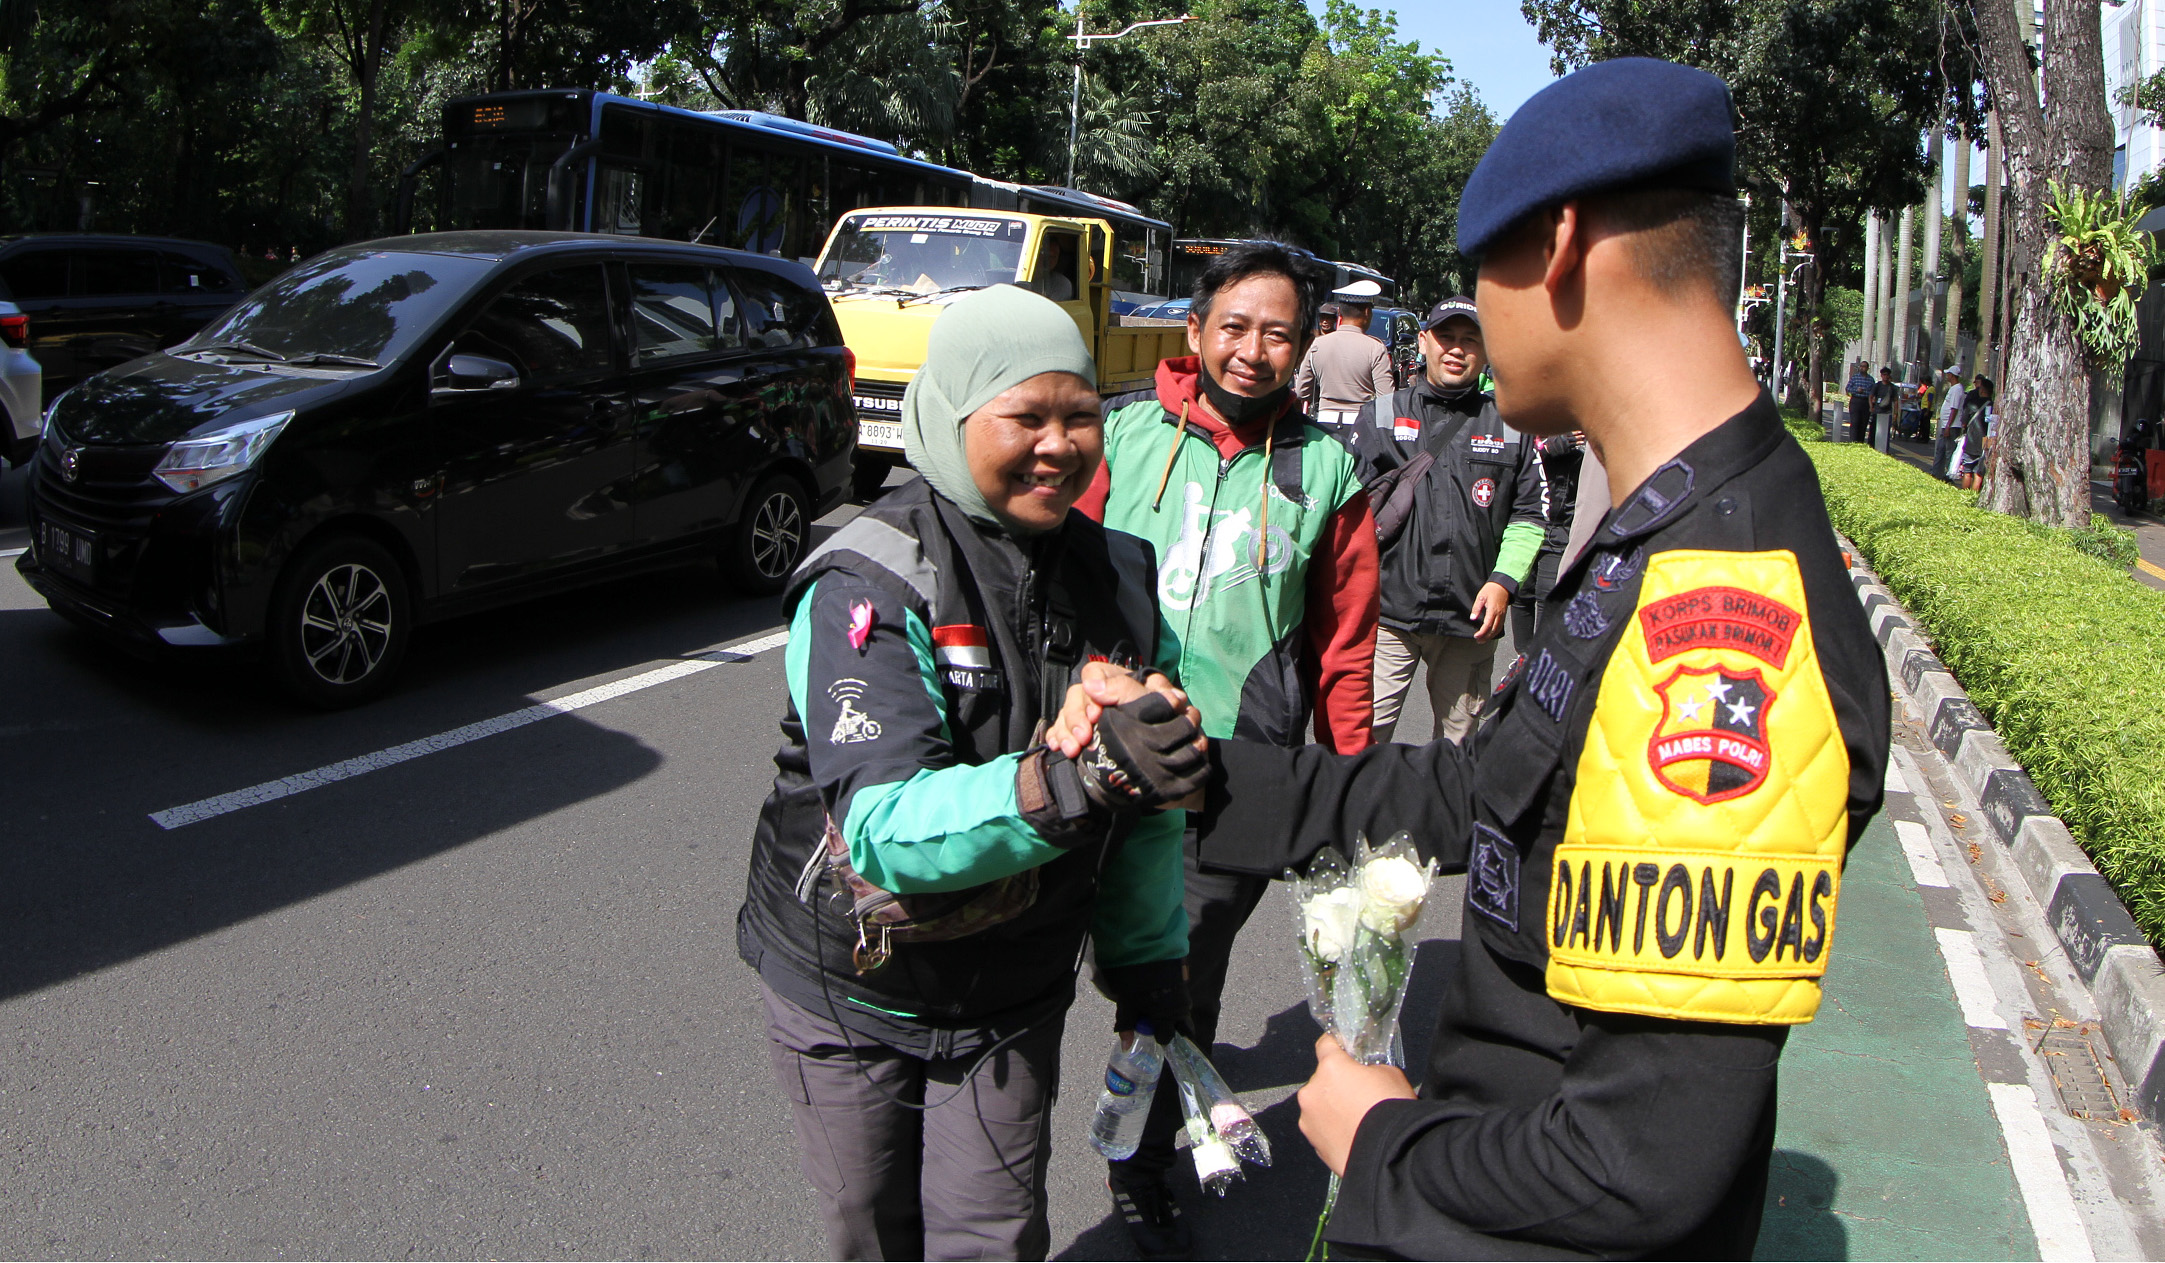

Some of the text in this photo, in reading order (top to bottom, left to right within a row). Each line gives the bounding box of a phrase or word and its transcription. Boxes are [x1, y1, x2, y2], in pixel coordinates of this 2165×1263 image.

[861, 217, 1001, 232] PERINTIS MUDA
[867, 425, 892, 440] 8893
[41, 521, 47, 545] B
[1649, 596, 1791, 632] KORPS BRIMOB
[1655, 623, 1717, 650] PASUKAN
[1723, 625, 1774, 652] BRIMOB
[1658, 736, 1764, 768] MABES POLRI
[1553, 859, 1832, 964] DANTON GAS
